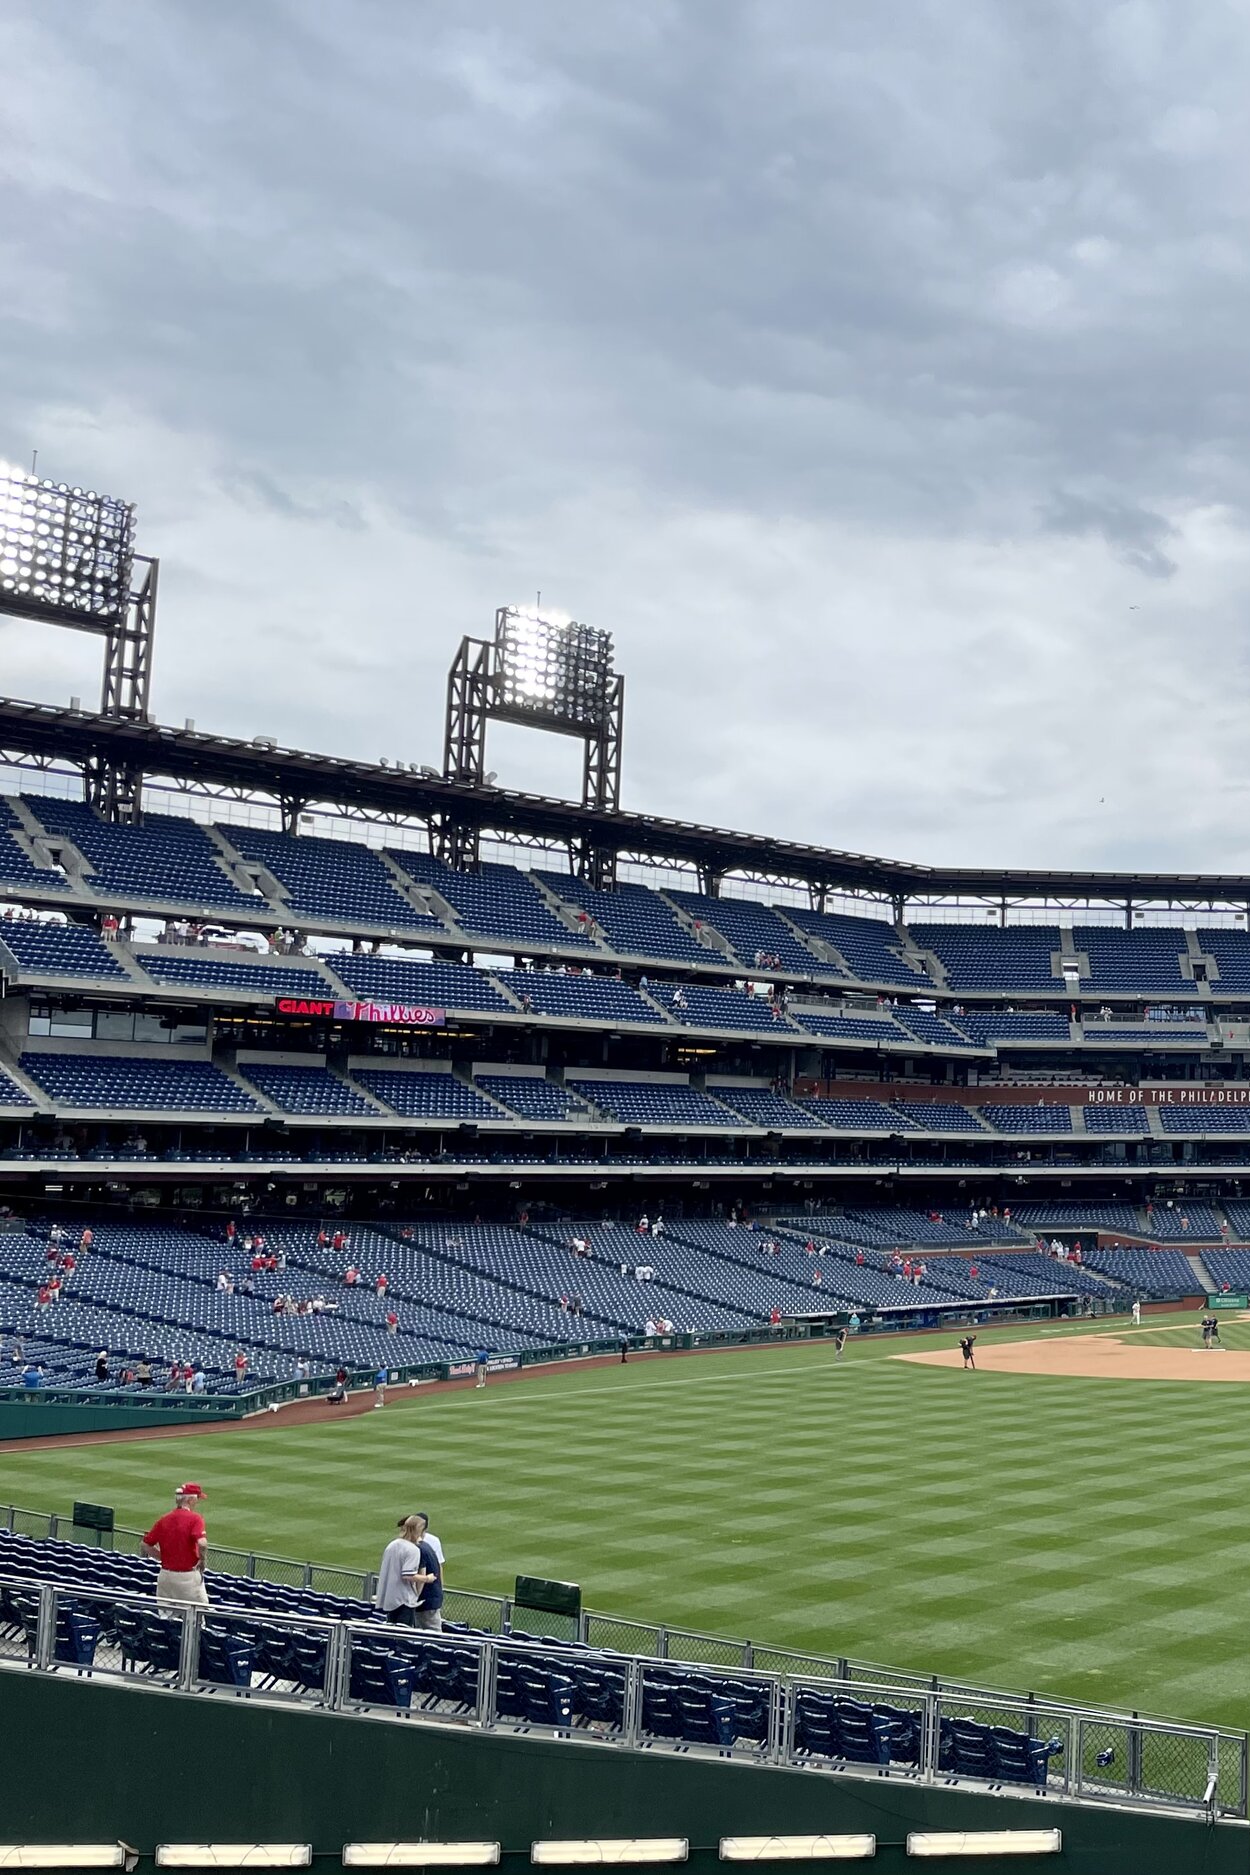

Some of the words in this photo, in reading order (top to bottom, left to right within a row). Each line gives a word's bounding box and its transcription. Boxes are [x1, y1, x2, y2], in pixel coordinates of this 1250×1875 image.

[278, 999, 334, 1015] GIANT
[345, 1001, 435, 1024] Phillies
[1088, 1090, 1123, 1102] HOME
[1129, 1090, 1144, 1102] OF
[1151, 1090, 1173, 1102] THE
